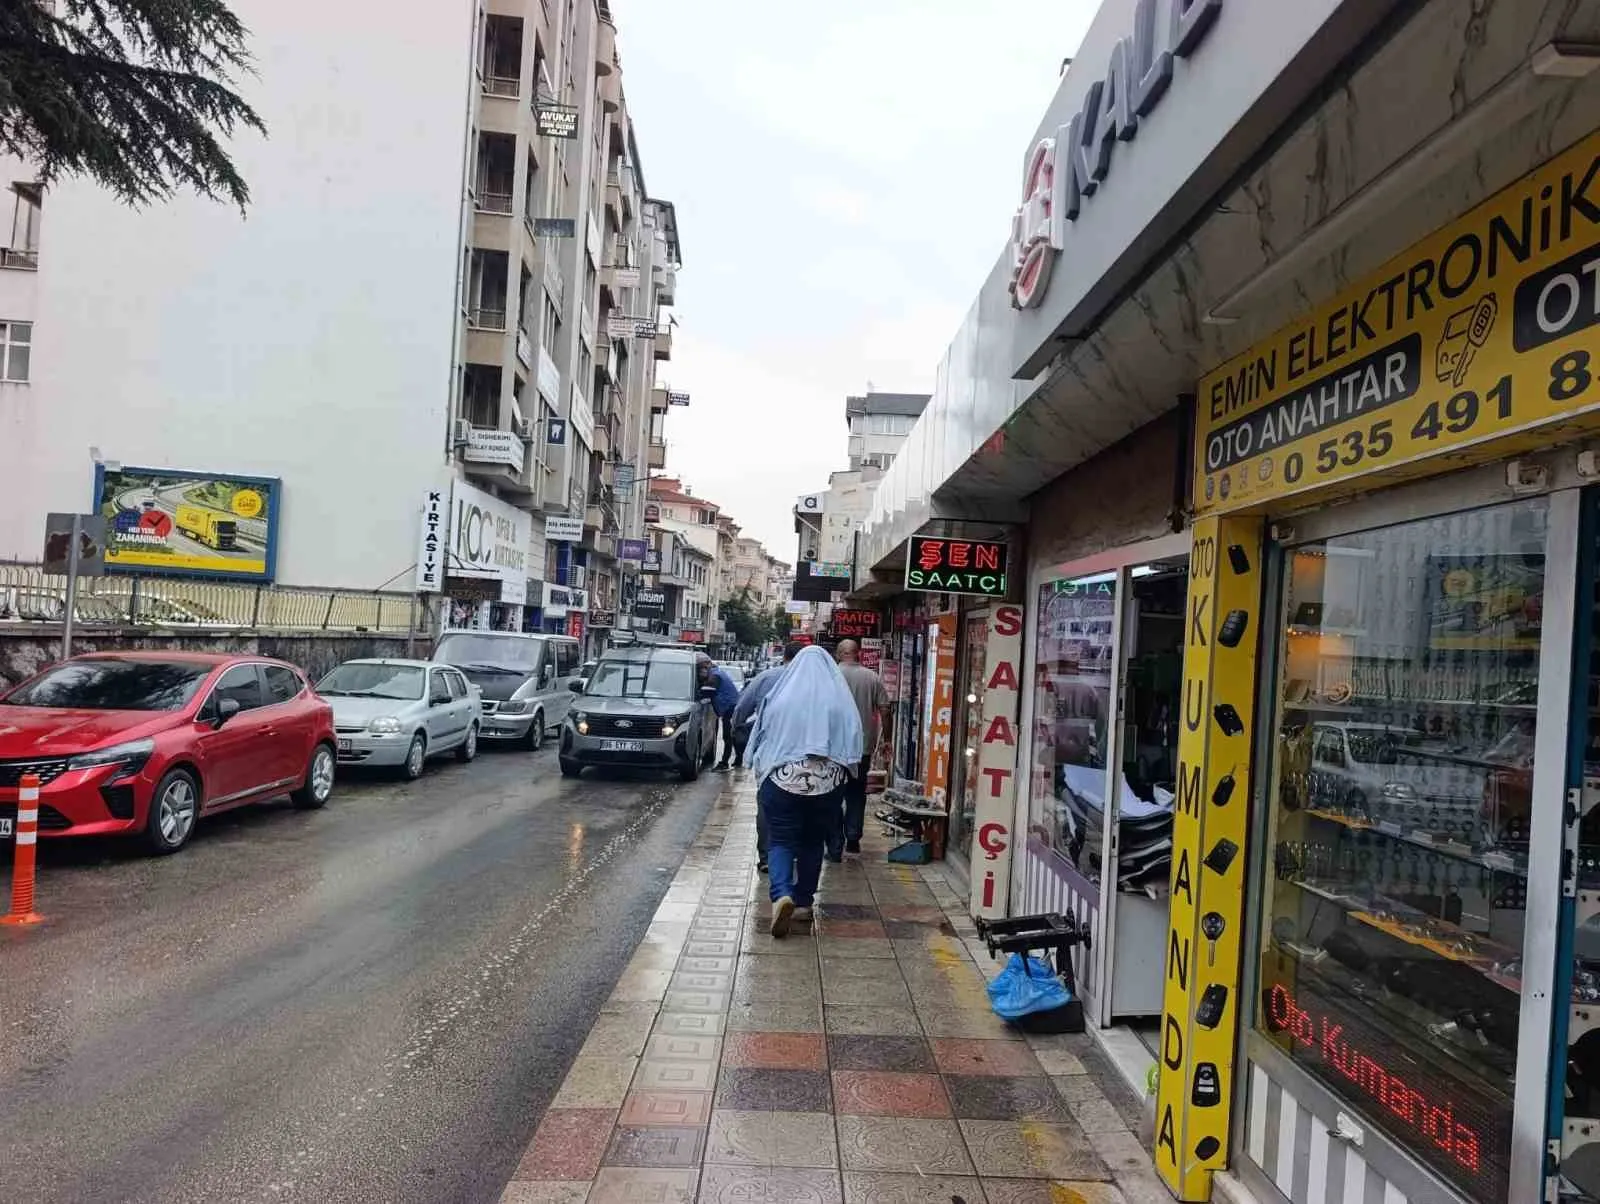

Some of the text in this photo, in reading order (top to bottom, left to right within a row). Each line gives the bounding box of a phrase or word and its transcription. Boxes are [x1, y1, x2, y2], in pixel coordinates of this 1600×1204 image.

[541, 111, 576, 122] AVUKAT
[1208, 352, 1407, 469] OTO ANAHTAR
[1284, 453, 1304, 484] 0
[1316, 419, 1393, 474] 535
[1410, 374, 1512, 441] 491
[116, 533, 167, 545] ZAMANINDA
[919, 540, 998, 570] ŞEN
[1191, 535, 1215, 580] OTO
[909, 570, 1006, 592] SAATÇİ
[978, 606, 1021, 908] SAATÇİ
[1158, 594, 1209, 1166] KUMANDA
[1321, 1015, 1480, 1176] Kumanda
